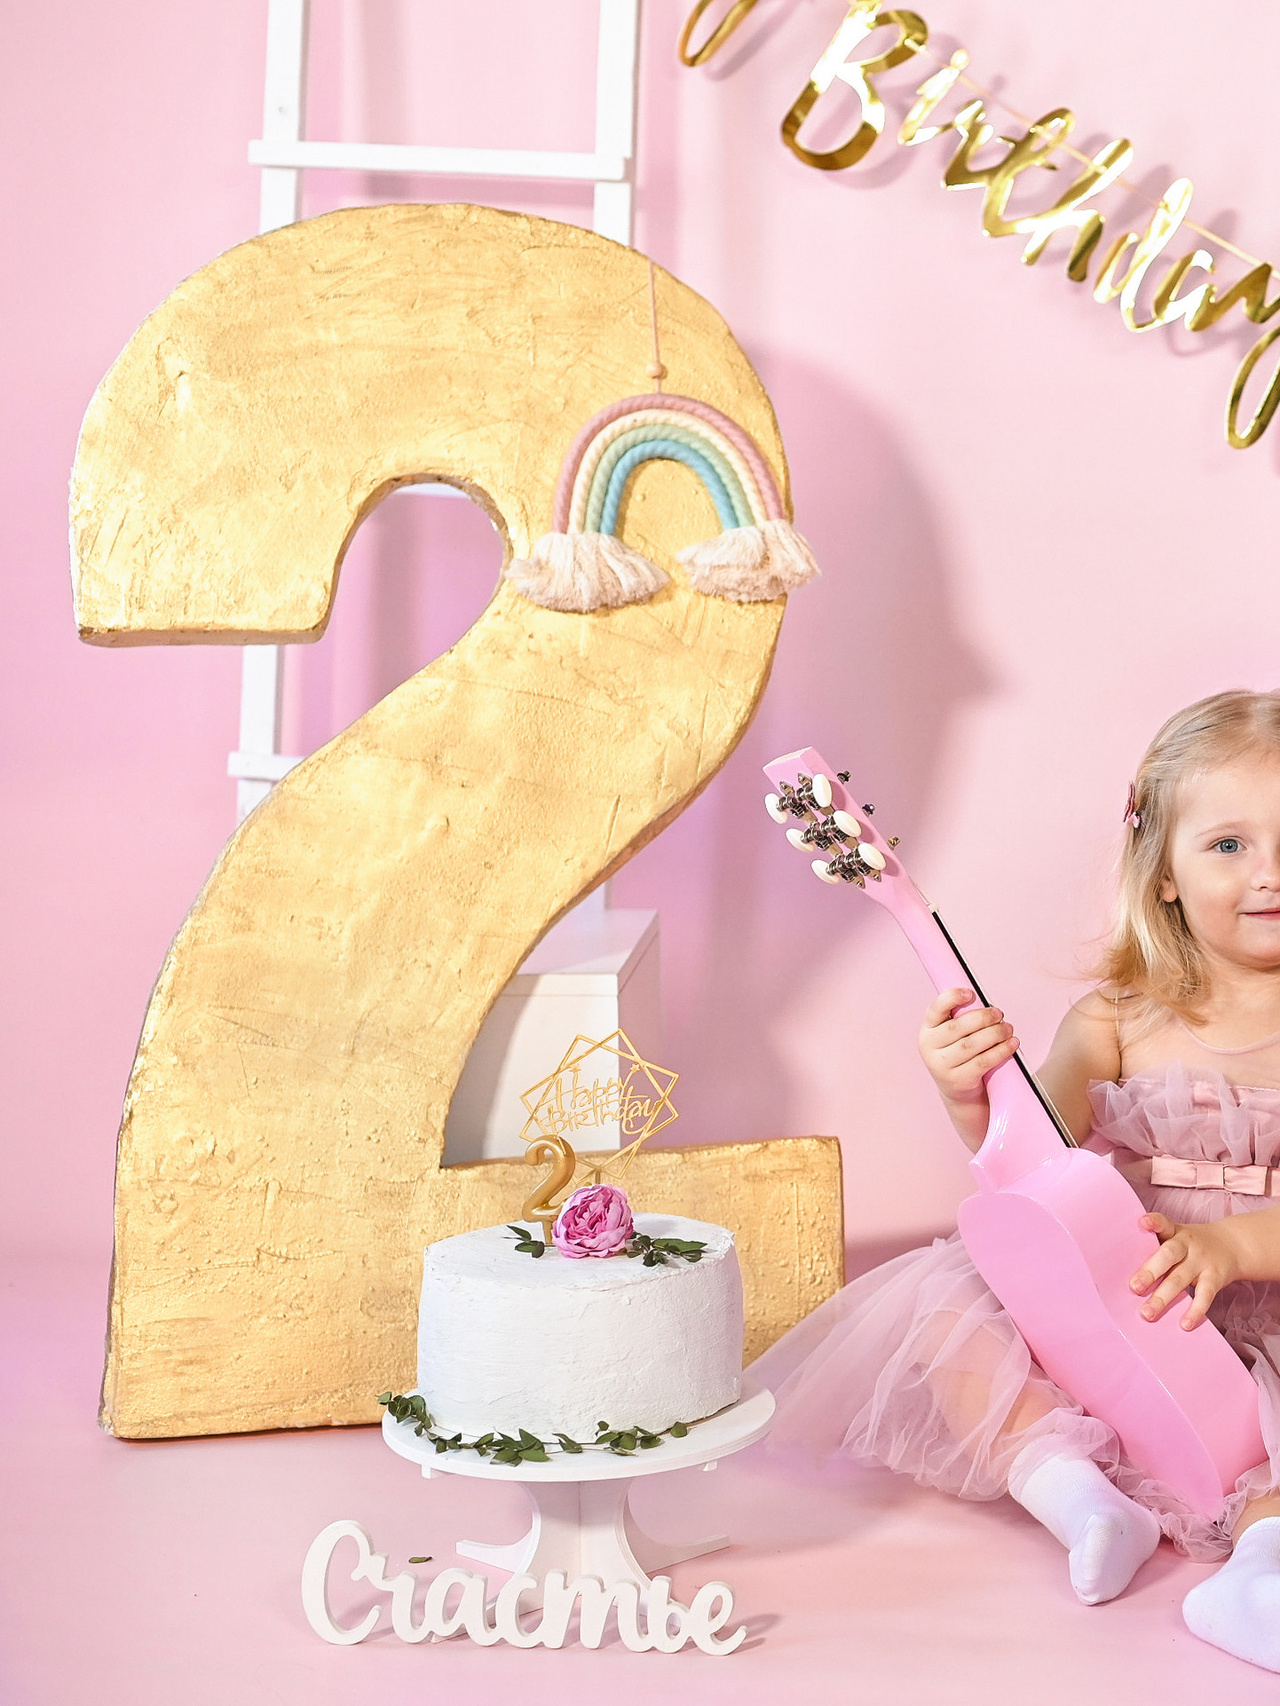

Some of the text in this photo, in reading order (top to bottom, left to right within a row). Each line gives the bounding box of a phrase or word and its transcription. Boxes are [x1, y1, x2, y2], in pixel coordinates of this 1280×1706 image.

[69, 202, 845, 1441] 2
[540, 1064, 640, 1110] Happy
[521, 1134, 576, 1223] 2
